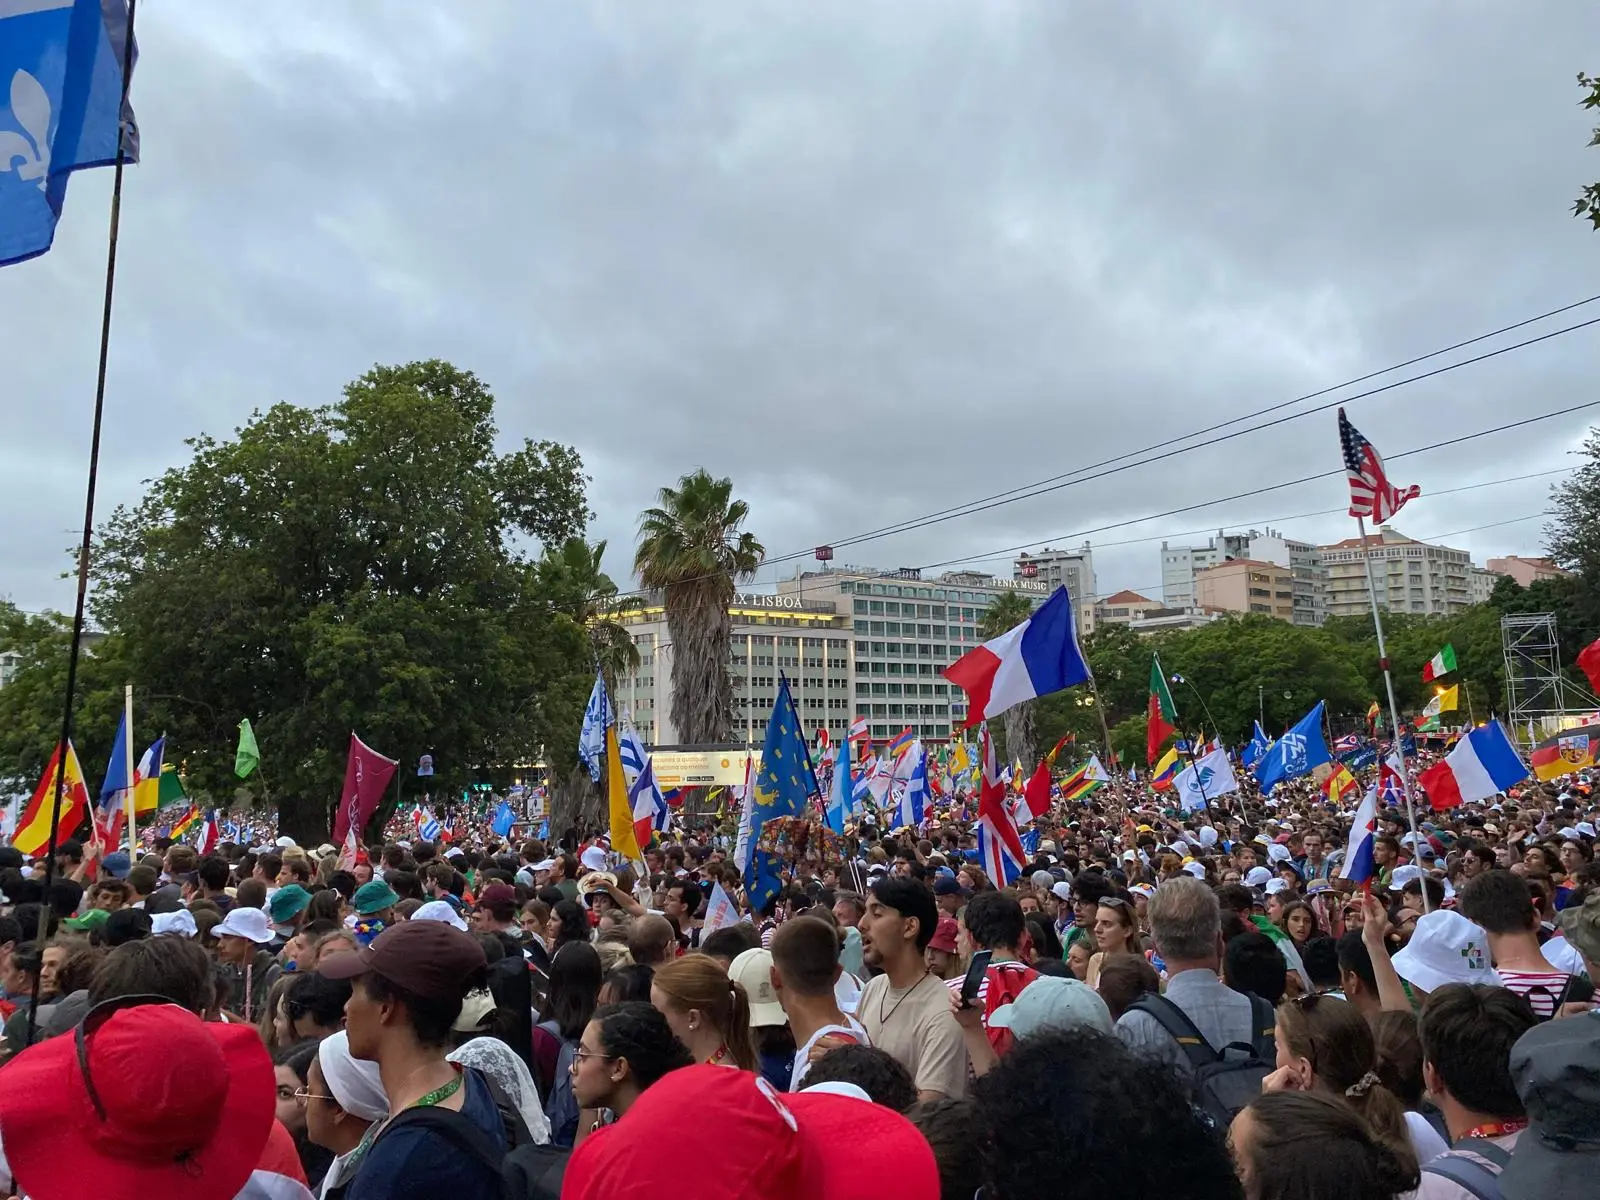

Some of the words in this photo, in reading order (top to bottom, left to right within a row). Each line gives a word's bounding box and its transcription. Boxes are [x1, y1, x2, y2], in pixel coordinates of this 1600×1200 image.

[992, 578, 1018, 588] FENIX
[1020, 581, 1047, 591] MUSIC
[753, 594, 803, 609] LISBOA
